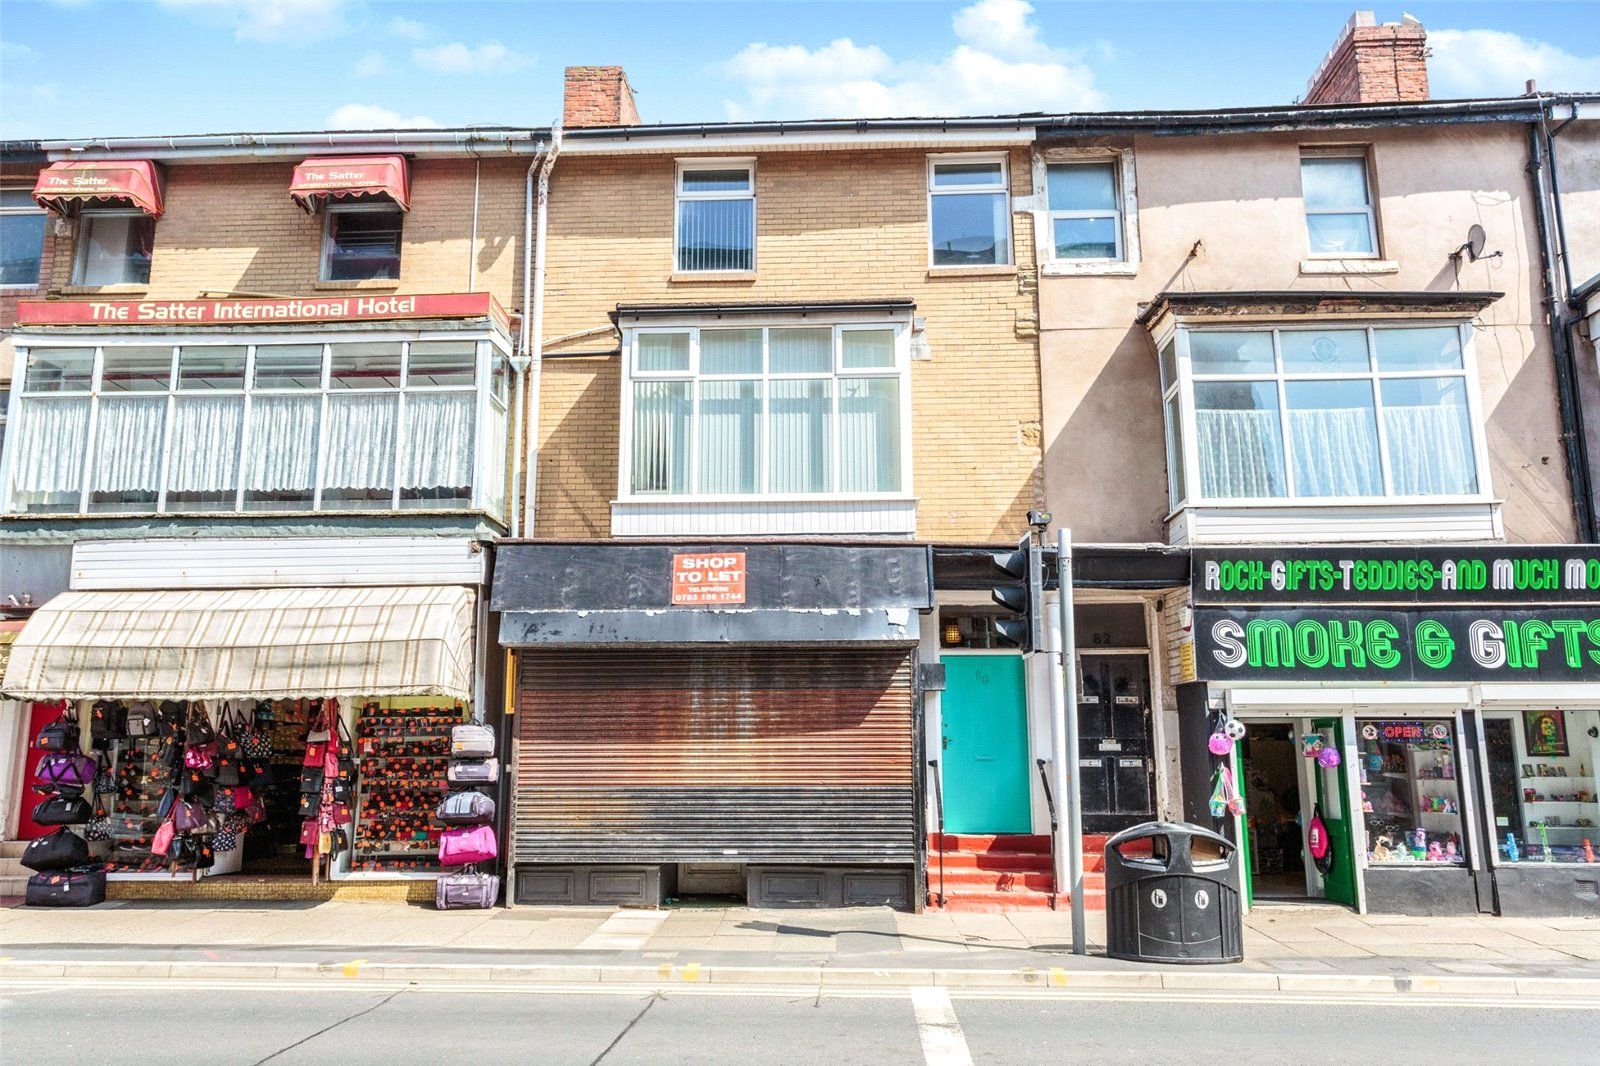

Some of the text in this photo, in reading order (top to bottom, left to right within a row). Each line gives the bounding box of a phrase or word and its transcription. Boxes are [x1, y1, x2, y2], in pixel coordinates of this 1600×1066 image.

[48, 176, 109, 185] The Satter
[305, 171, 366, 180] The Satter
[89, 296, 415, 320] The Satter International Hotel
[682, 557, 737, 569] SHOP
[676, 570, 742, 583] TO LET
[1492, 558, 1559, 590] MUCH
[1211, 619, 1401, 669] SMOKE
[1384, 726, 1421, 738] OPEN
